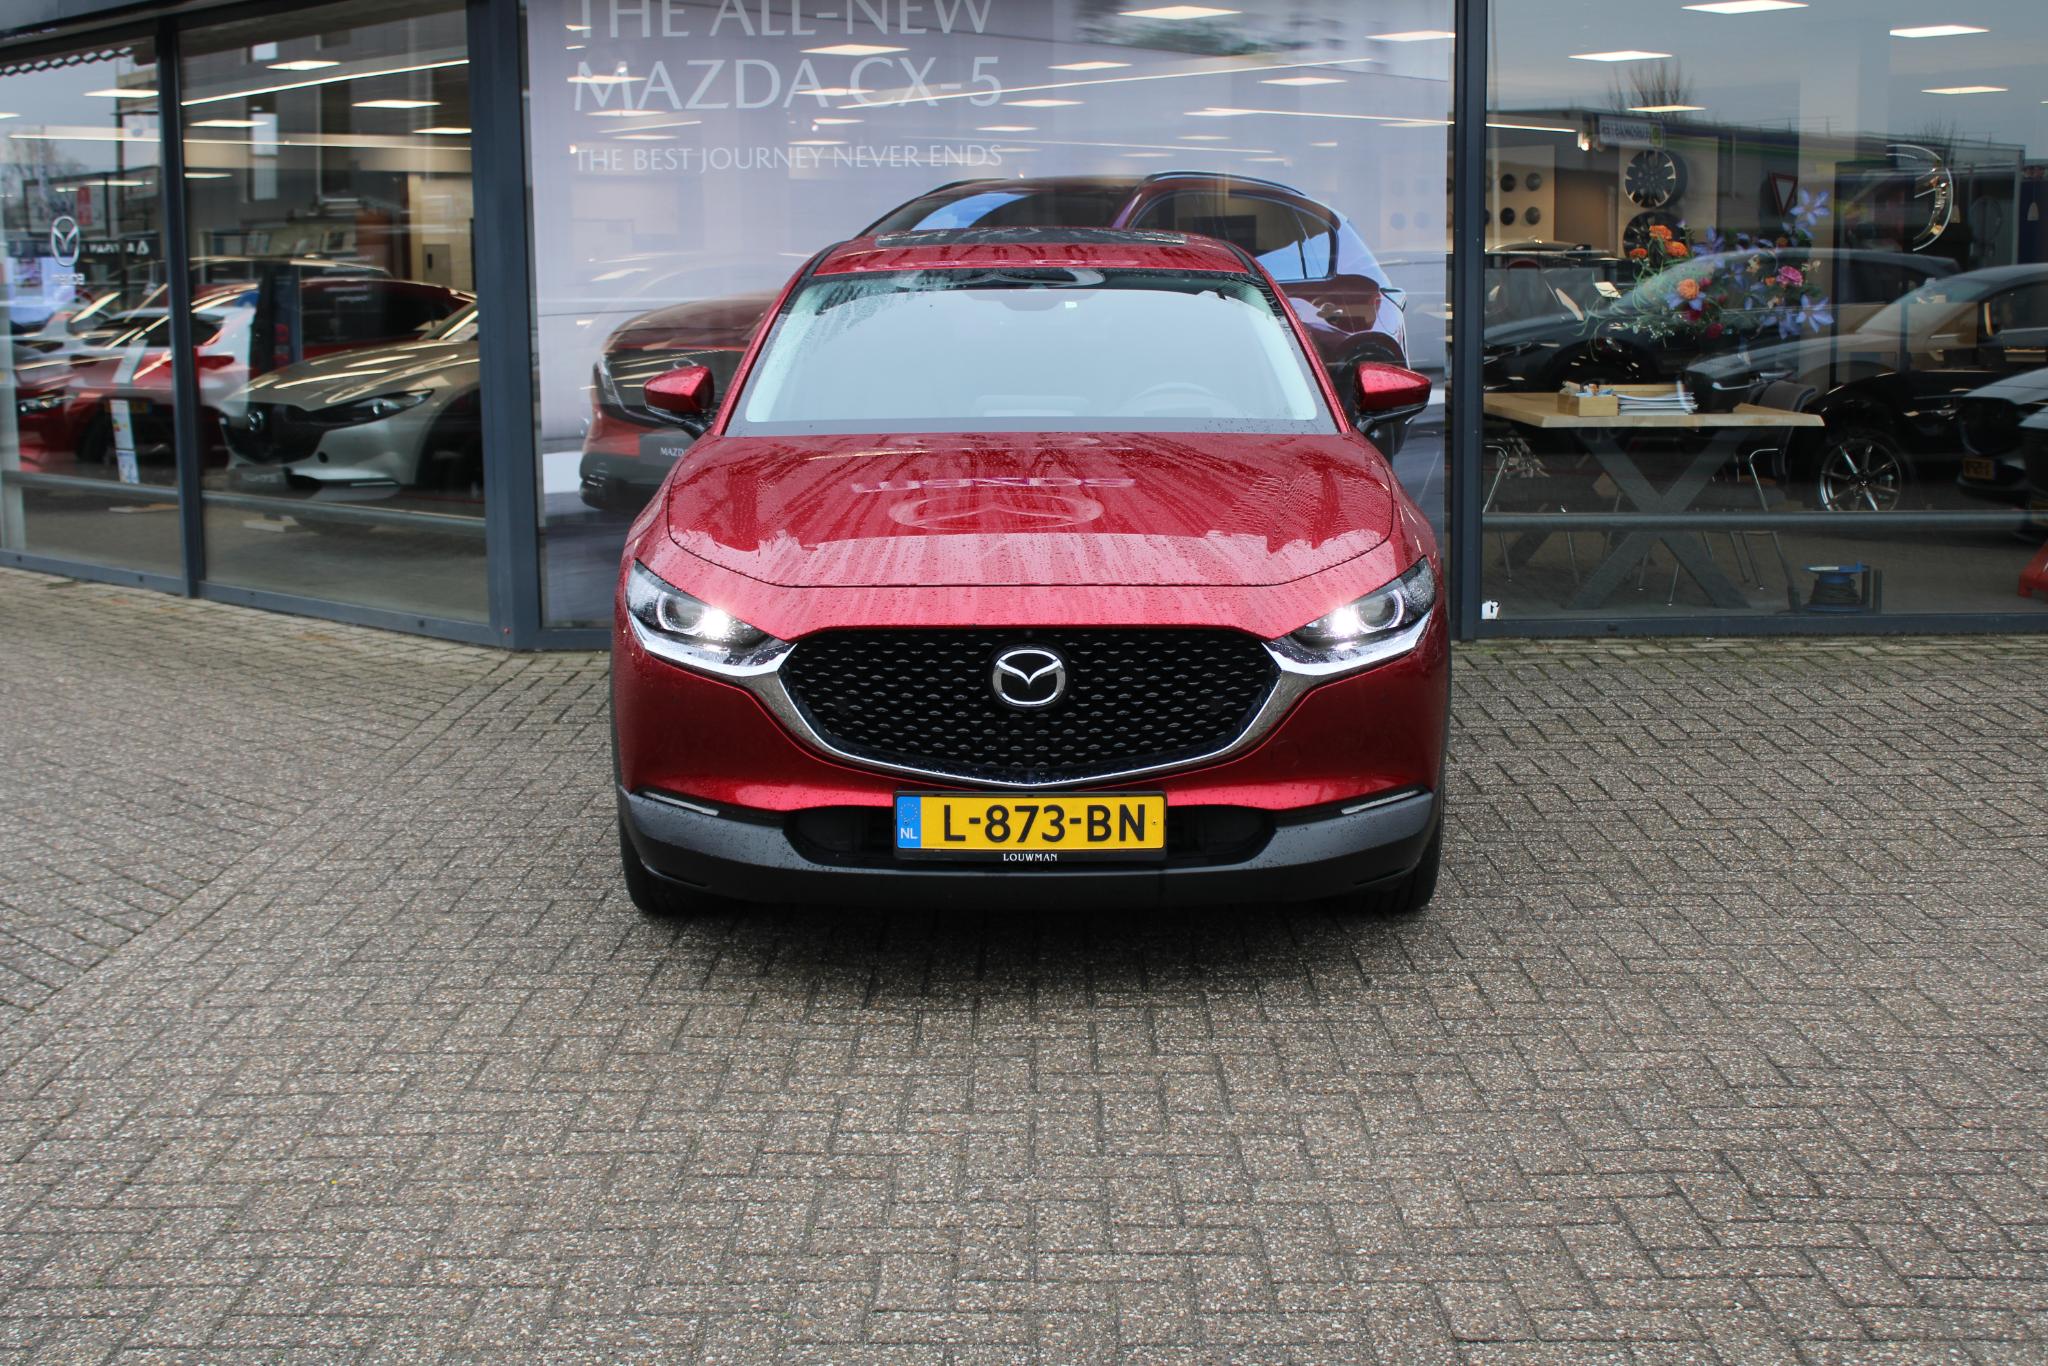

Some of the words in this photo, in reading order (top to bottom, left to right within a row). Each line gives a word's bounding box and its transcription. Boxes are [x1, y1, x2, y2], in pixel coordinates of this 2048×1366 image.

[582, 0, 690, 38] THE
[709, 0, 991, 36] ALL-NEW
[573, 57, 828, 112] MAZDA
[847, 55, 1002, 107] CX-5
[576, 148, 624, 172] THE
[633, 147, 692, 171] BEST
[699, 146, 825, 174] JOURNEY
[833, 145, 922, 168] NEVER
[929, 144, 1003, 168] ENDS
[660, 447, 689, 457] MAZD
[900, 827, 918, 840] NL
[943, 803, 1146, 843] L-873-BN
[1002, 852, 1059, 862] LOUWMAN
